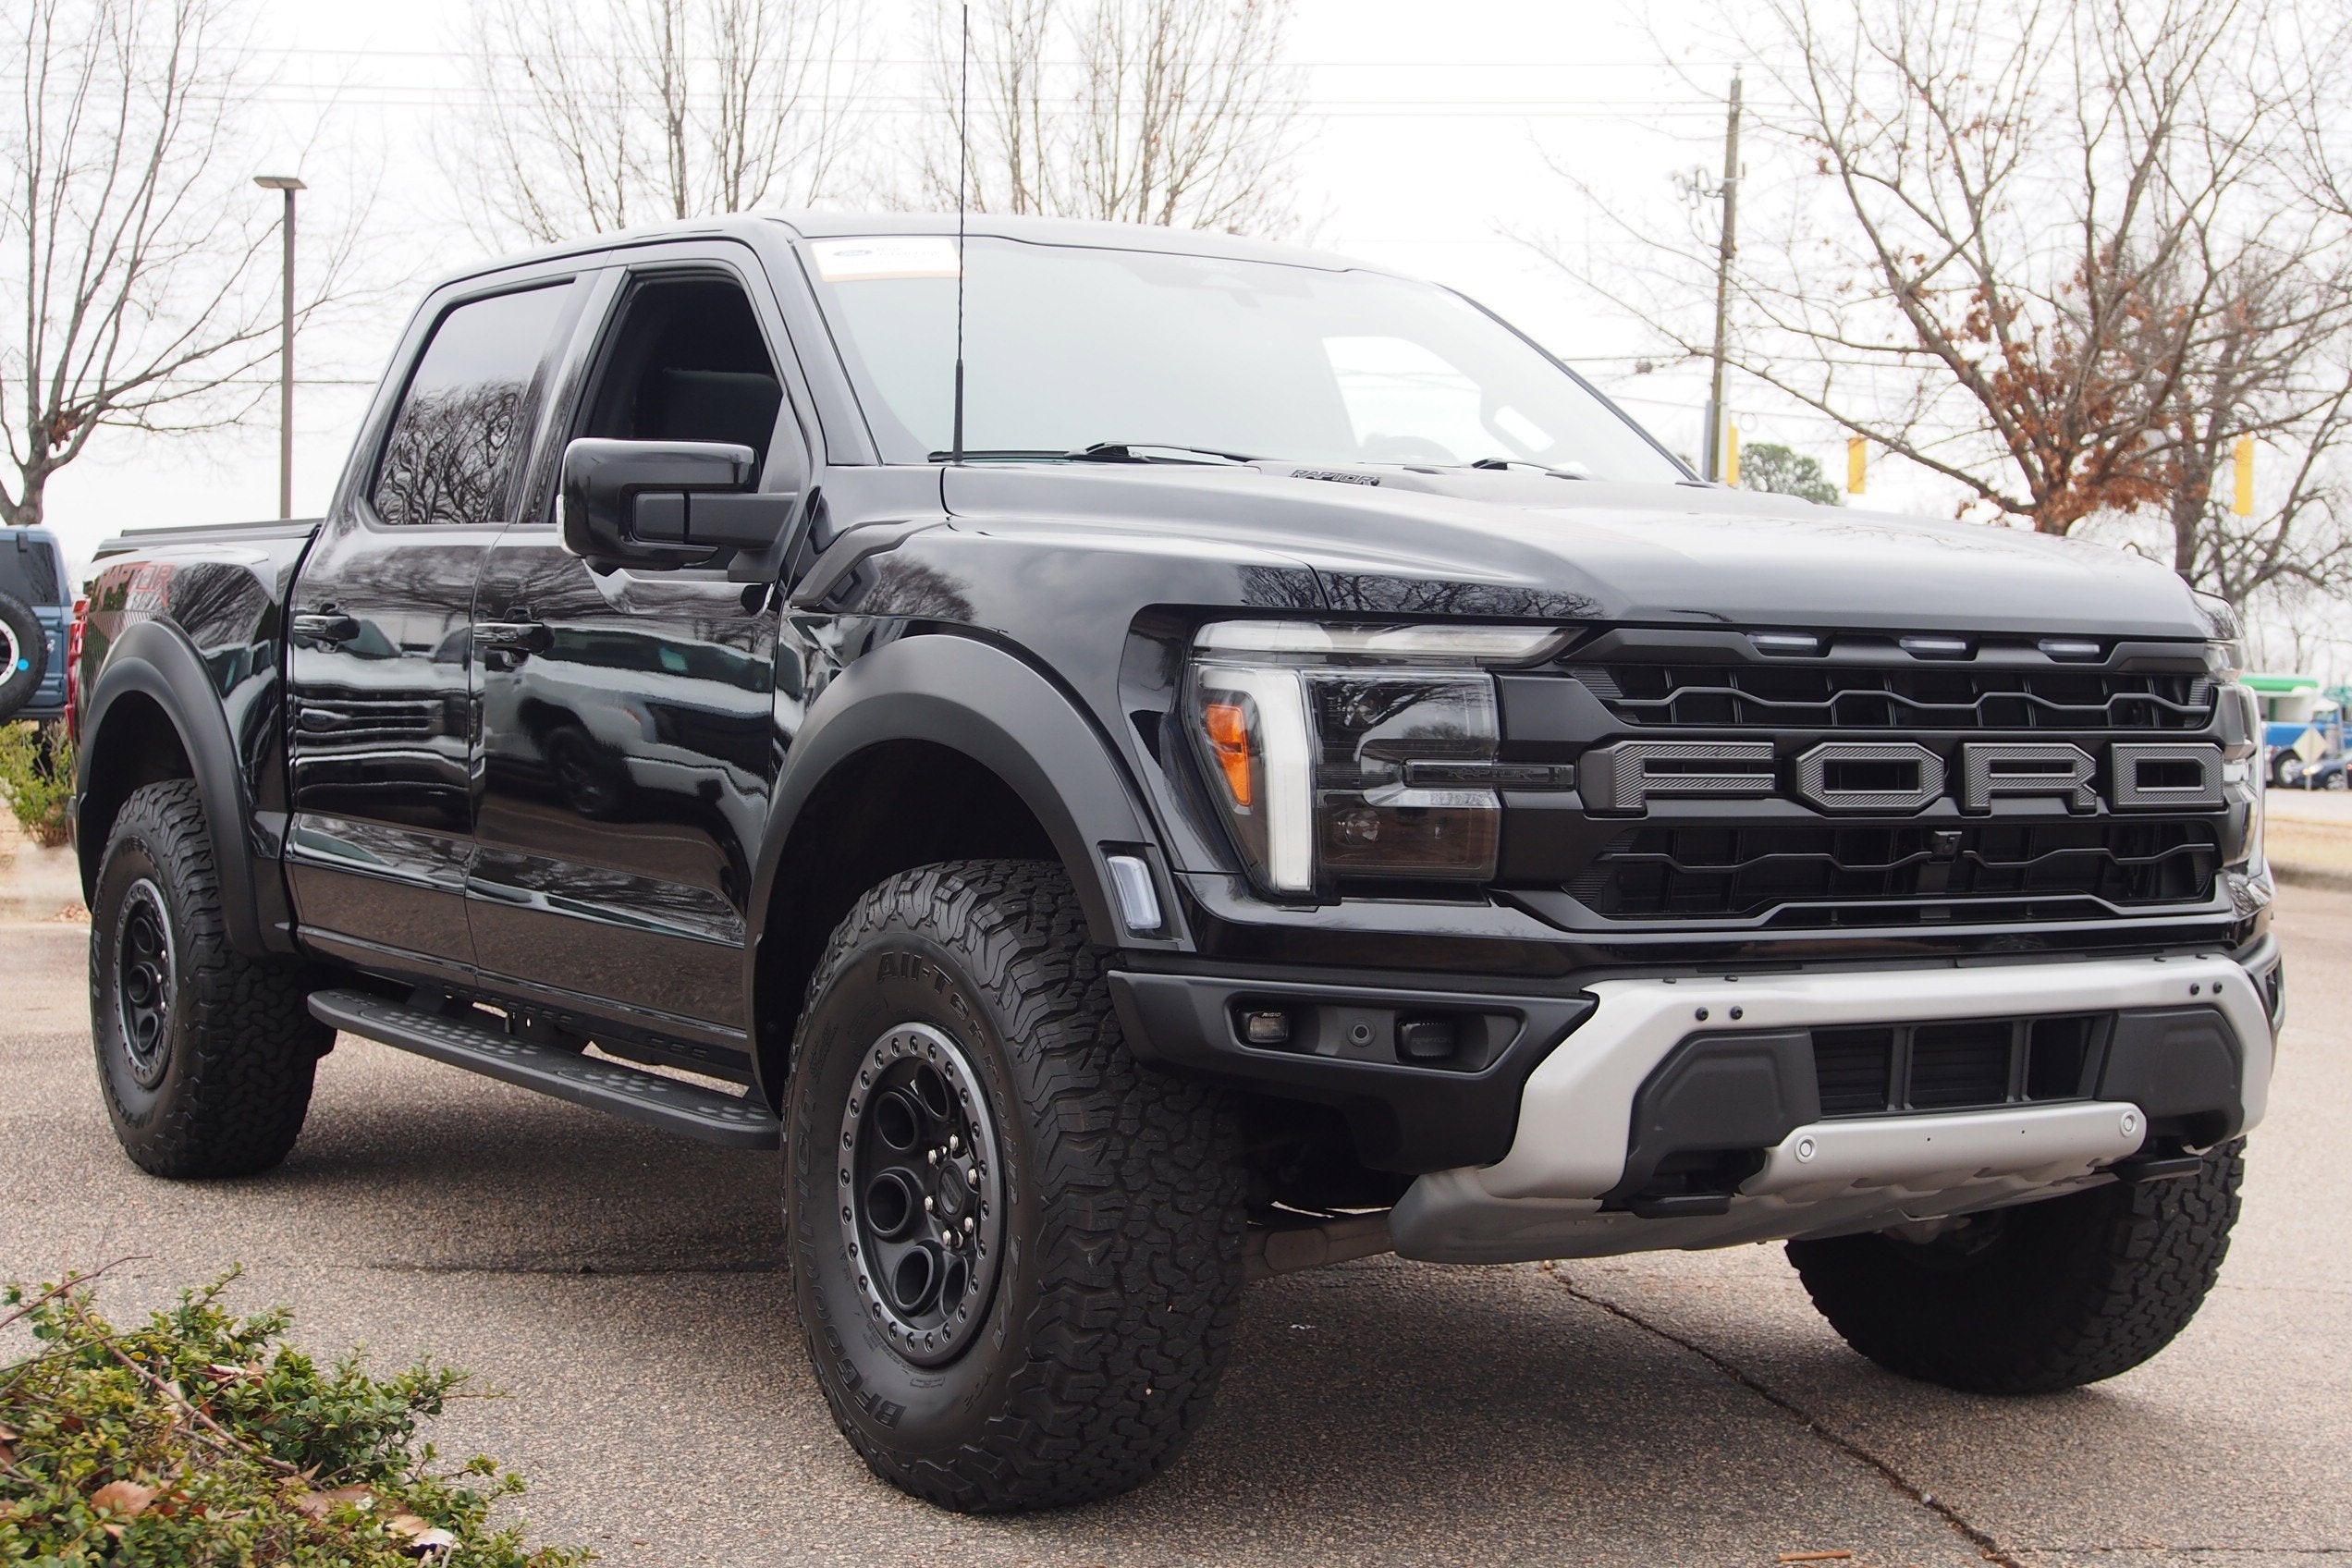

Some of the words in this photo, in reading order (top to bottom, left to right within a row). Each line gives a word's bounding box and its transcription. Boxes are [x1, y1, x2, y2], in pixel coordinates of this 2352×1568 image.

[1290, 469, 1376, 486] RAPTOR
[94, 561, 177, 608] RAPTOR
[1579, 741, 2223, 816] FORD
